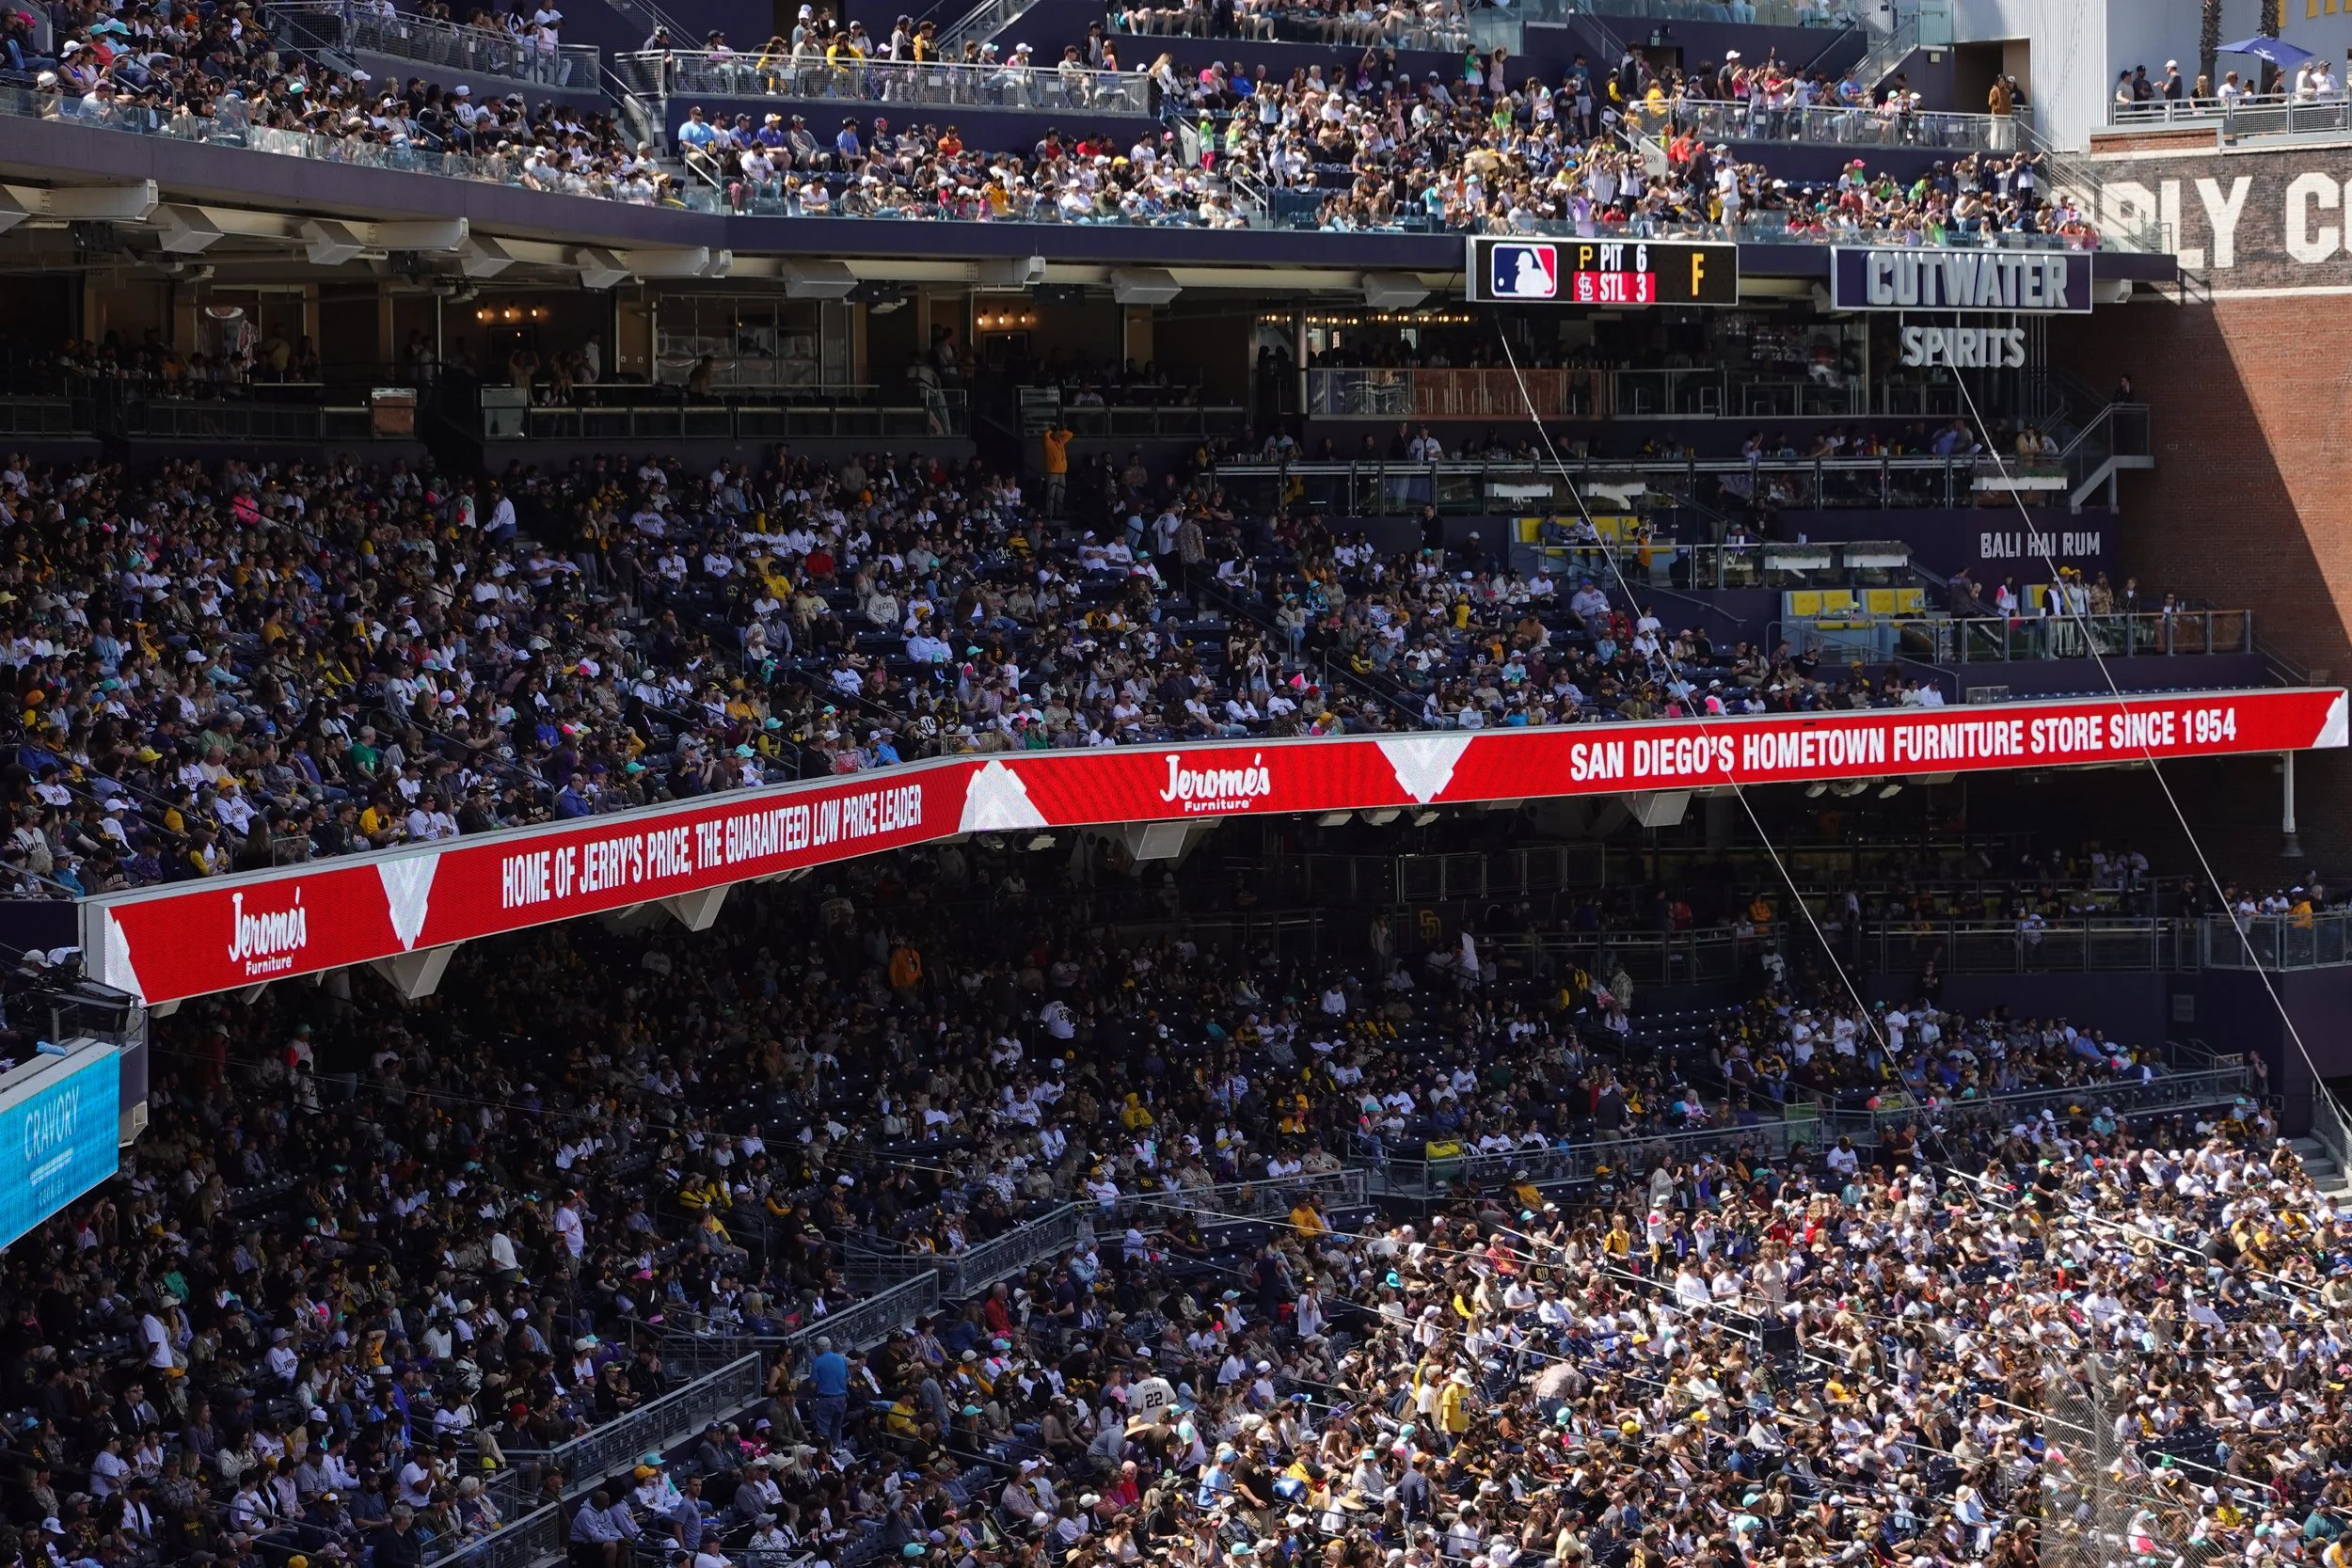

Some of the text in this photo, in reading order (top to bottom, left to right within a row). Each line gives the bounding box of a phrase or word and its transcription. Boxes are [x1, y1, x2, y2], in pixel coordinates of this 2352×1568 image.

[2286, 172, 2352, 263] C
[1600, 244, 1624, 271] PIT
[1636, 244, 1646, 273] 6
[1692, 253, 1704, 296] F
[1867, 251, 2069, 308] CUTWATER
[1600, 273, 1626, 301] STL
[1636, 273, 1646, 302] 3
[1901, 326, 2025, 368] SPIRITS
[1980, 531, 2100, 559] BALI HAI RUM
[1570, 707, 2236, 781] SAN DIEGO'S HOMETOWN FURNITURE STORE SINCE 1954
[1159, 752, 1271, 801] Jerome's
[1184, 799, 1250, 812] Furniture
[502, 784, 922, 909] HOME OF JERRY'S PRICE, THE GUARANTEED LOW PRICE LEADER
[228, 886, 307, 962] Jerome's
[246, 955, 293, 976] Furniture
[24, 1085, 79, 1162] CRAVORY
[1145, 1391, 1163, 1409] 22
